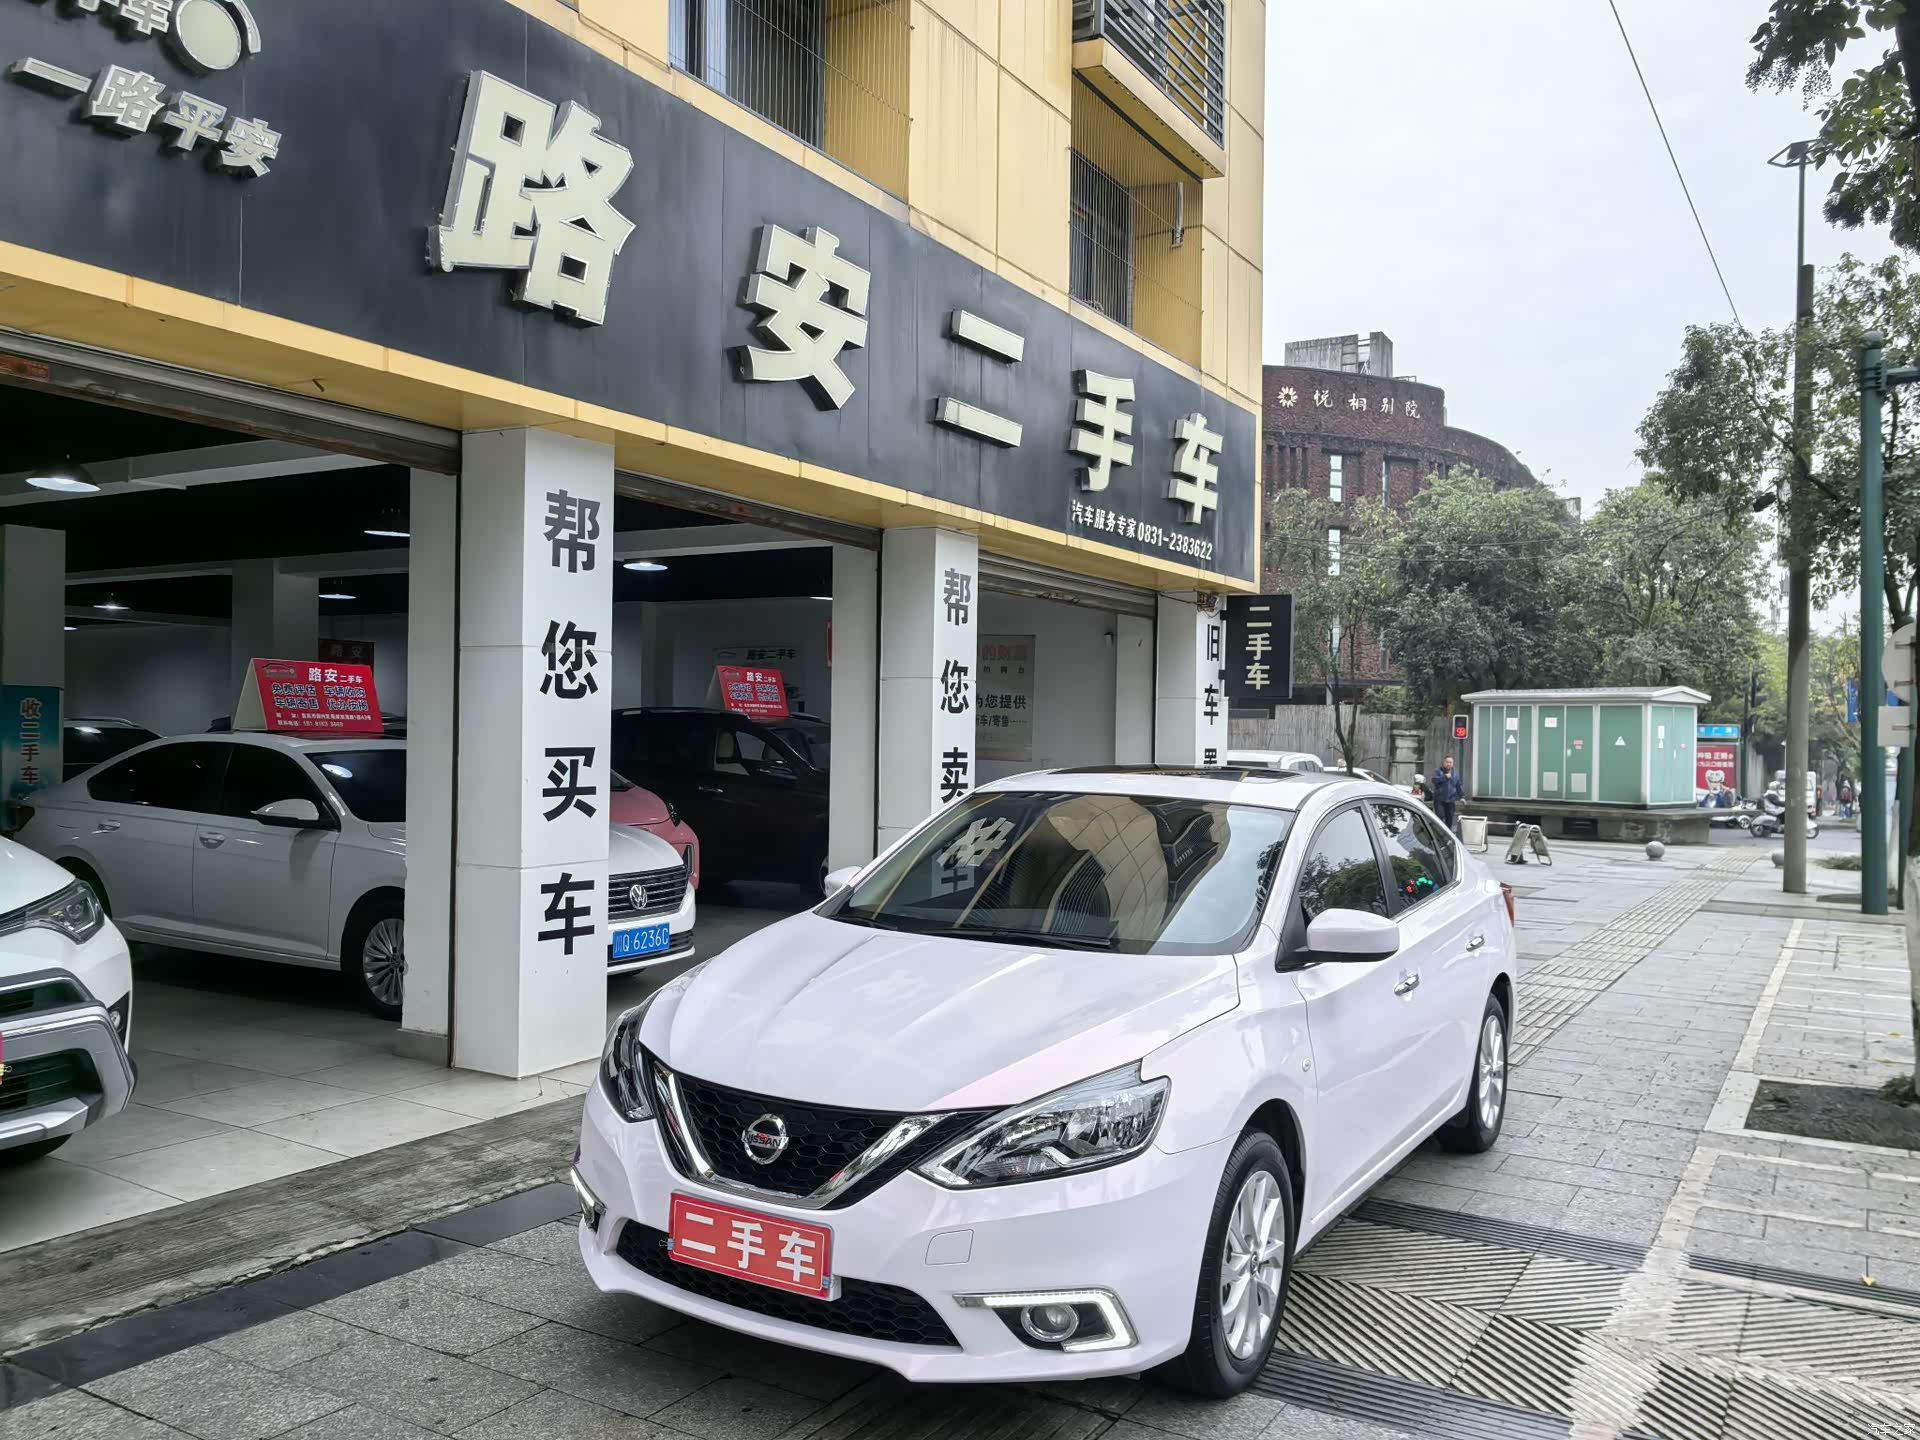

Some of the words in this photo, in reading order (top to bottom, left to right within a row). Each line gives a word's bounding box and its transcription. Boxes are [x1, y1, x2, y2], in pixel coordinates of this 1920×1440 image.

[11, 57, 282, 177] 一路平安
[425, 69, 1223, 525] 路安二手车
[1313, 389, 1420, 419] 悦桐别院
[1245, 606, 1273, 691] 二手车
[20, 698, 42, 785] 收二手车
[537, 489, 601, 956] 帮您买车
[743, 1133, 782, 1148] NISSAN
[681, 1211, 816, 1282] 二手车
